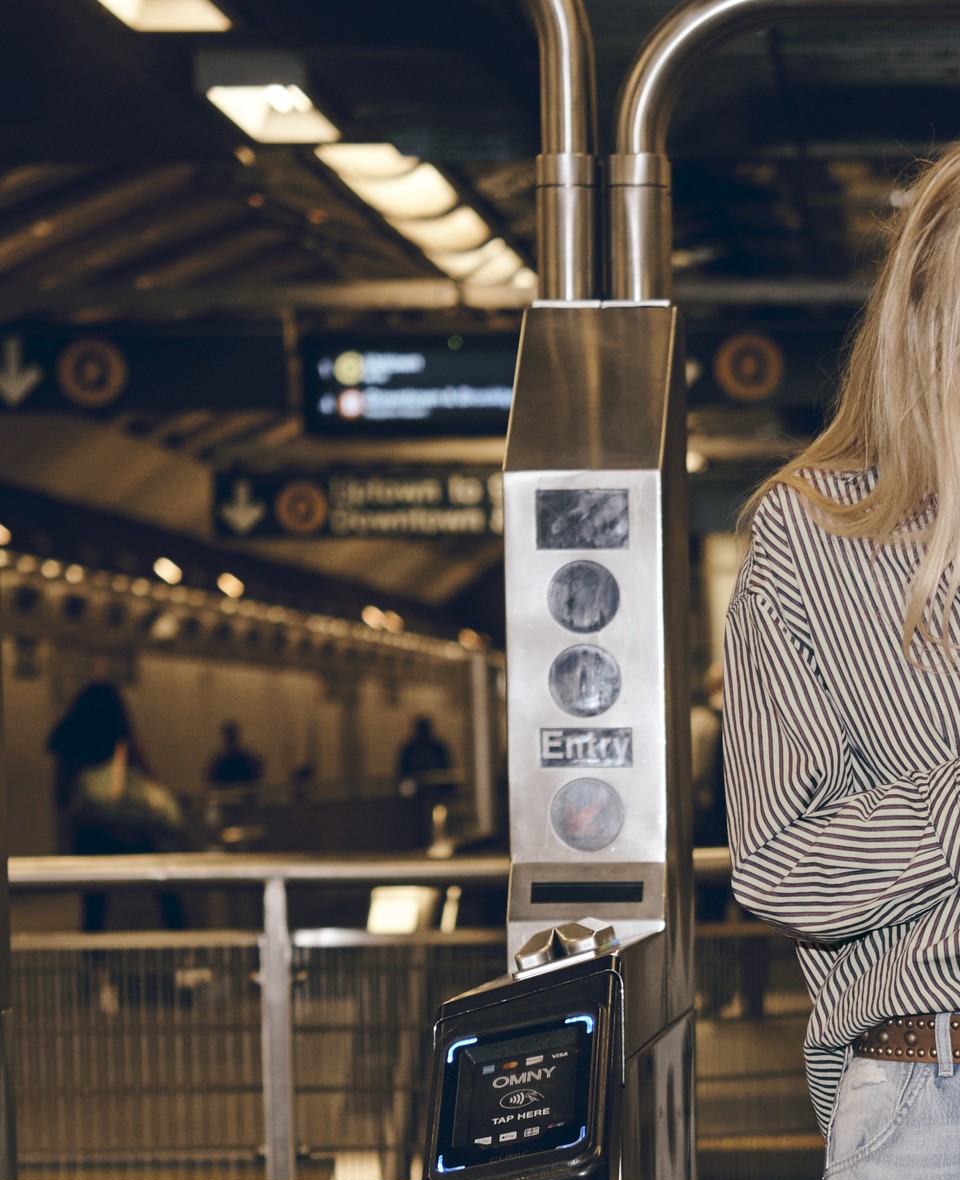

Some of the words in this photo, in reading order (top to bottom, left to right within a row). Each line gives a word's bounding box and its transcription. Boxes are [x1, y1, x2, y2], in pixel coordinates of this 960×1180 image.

[542, 730, 630, 765] Entry
[551, 1051, 568, 1059] VISA
[492, 1066, 556, 1089] OMNY
[492, 1115, 514, 1125] TAP
[517, 1107, 550, 1121] HERE
